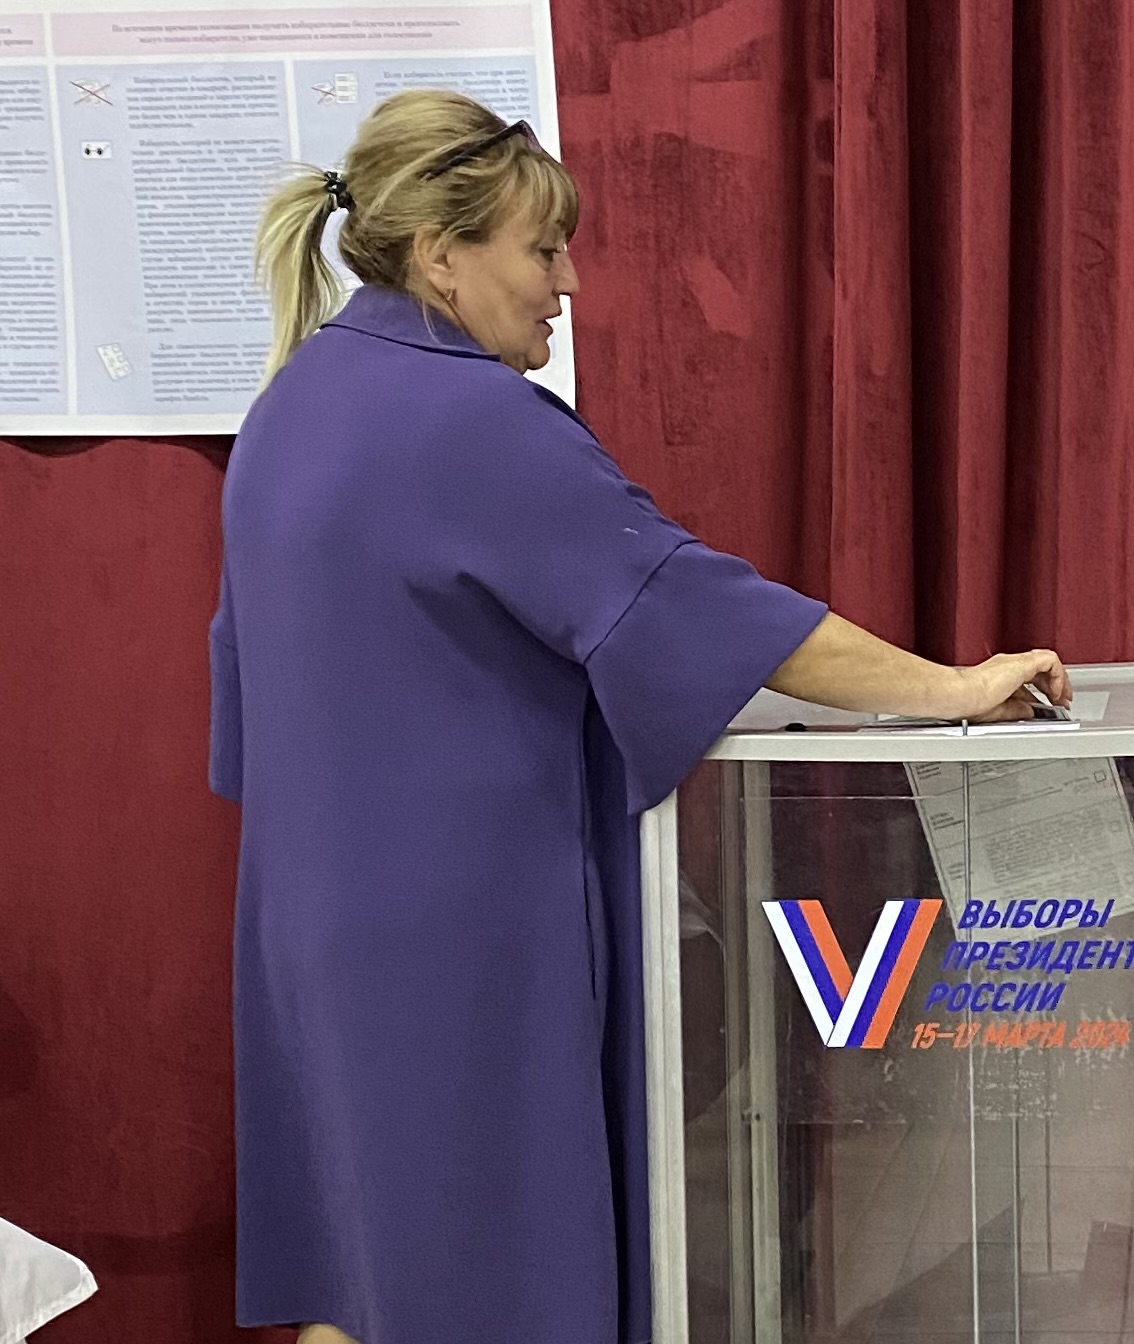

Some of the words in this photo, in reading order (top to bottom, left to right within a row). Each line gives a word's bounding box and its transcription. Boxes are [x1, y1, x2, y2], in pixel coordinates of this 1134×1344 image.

[957, 899, 1115, 929] ВЫБОРЫ
[924, 982, 1067, 1013] РОССИИ
[979, 1019, 1068, 1049] МАРТА
[1068, 1019, 1131, 1049] 2024
